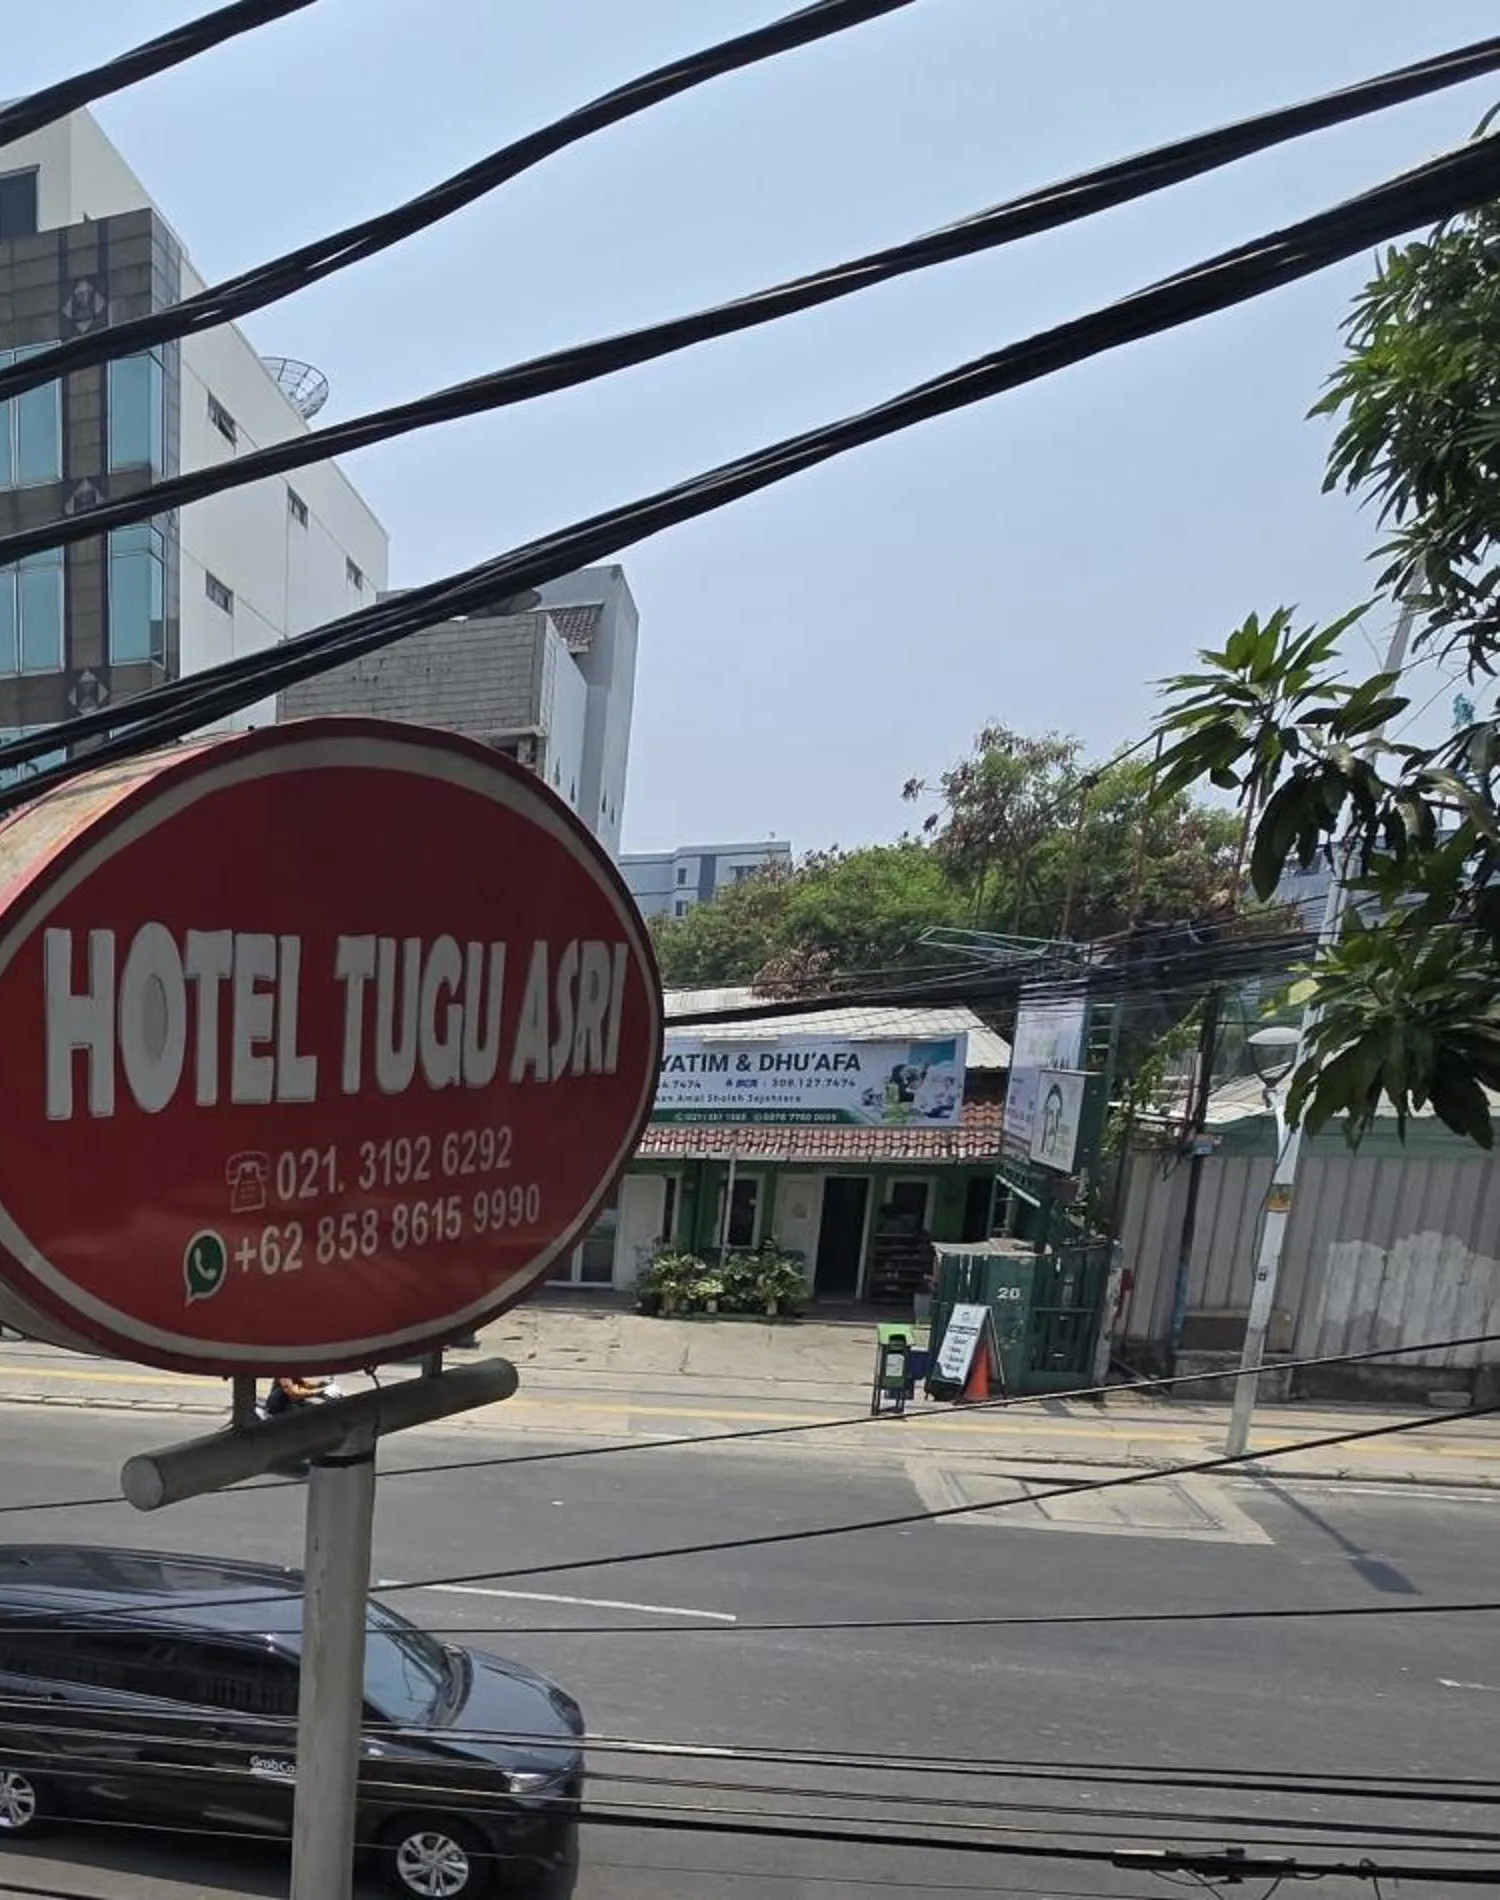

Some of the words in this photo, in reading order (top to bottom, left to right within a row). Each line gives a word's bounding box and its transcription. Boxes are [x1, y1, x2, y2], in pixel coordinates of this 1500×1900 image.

[43, 922, 318, 1121] HOTEL
[333, 934, 507, 1094] TUGU
[511, 938, 628, 1083] ASRI
[735, 1053, 751, 1072] &
[276, 1145, 345, 1201] 021.
[358, 1136, 431, 1190] 3192
[441, 1125, 513, 1176] 6292
[234, 1220, 303, 1275] +62
[316, 1209, 379, 1265] 858
[391, 1195, 462, 1250] 8615
[473, 1183, 541, 1233] 9990
[996, 1287, 1021, 1300] 20
[250, 1755, 296, 1773] GrabCa
